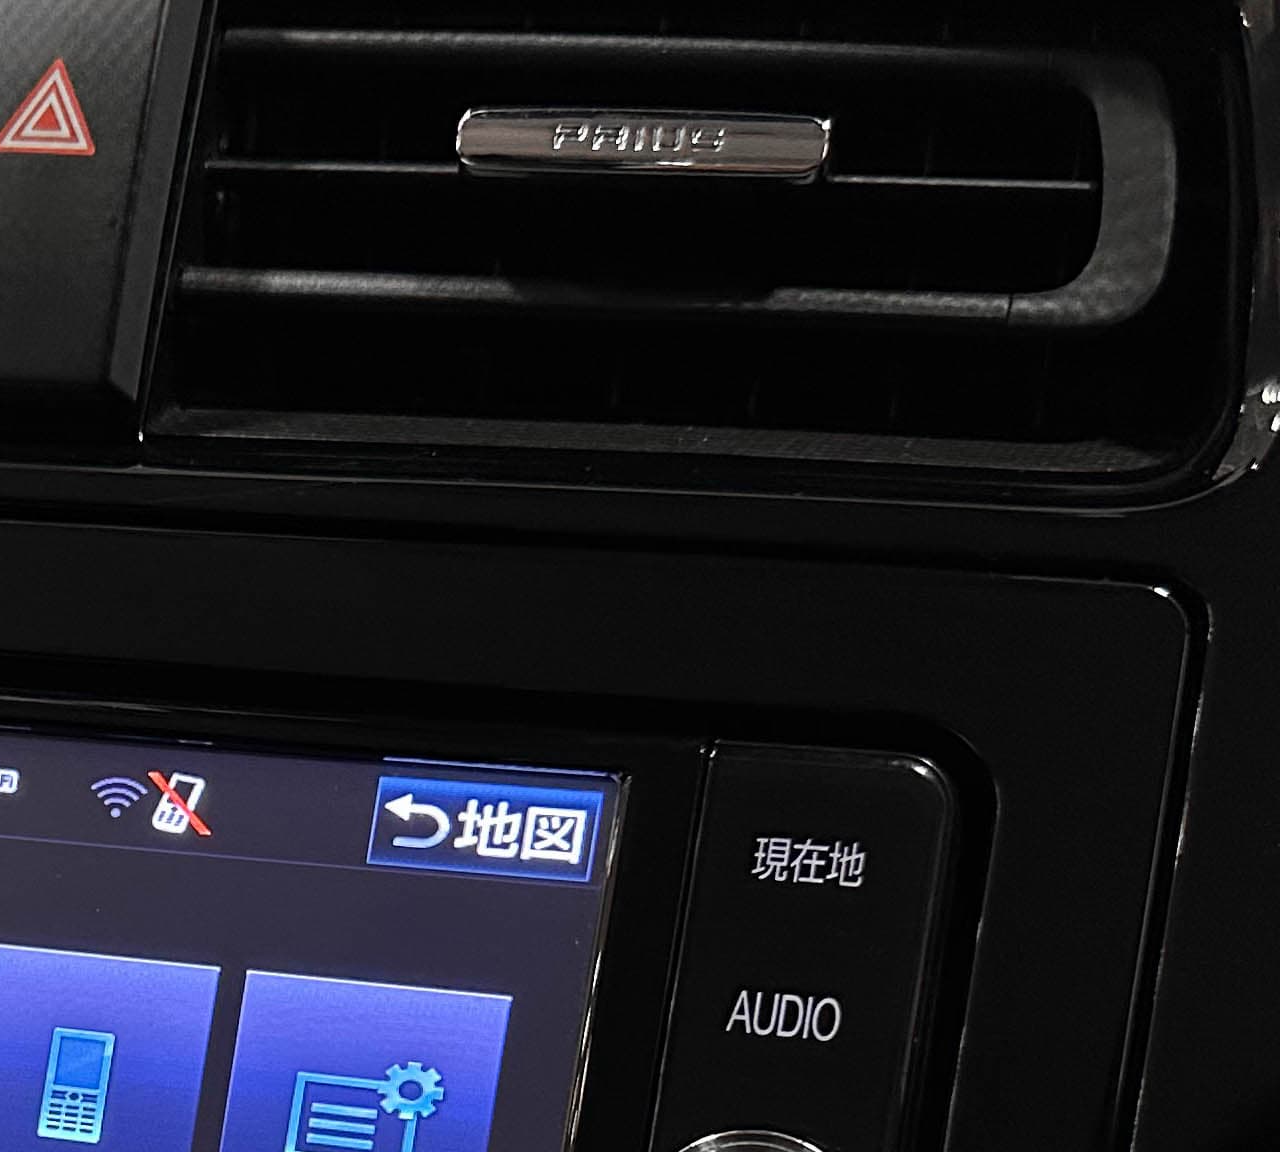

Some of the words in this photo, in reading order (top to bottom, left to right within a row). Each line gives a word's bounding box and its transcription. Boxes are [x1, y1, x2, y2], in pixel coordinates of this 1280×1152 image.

[552, 123, 726, 152] PRIUS
[452, 798, 589, 865] 地図
[751, 836, 867, 889] 現在地
[725, 989, 842, 1042] AUDIO
